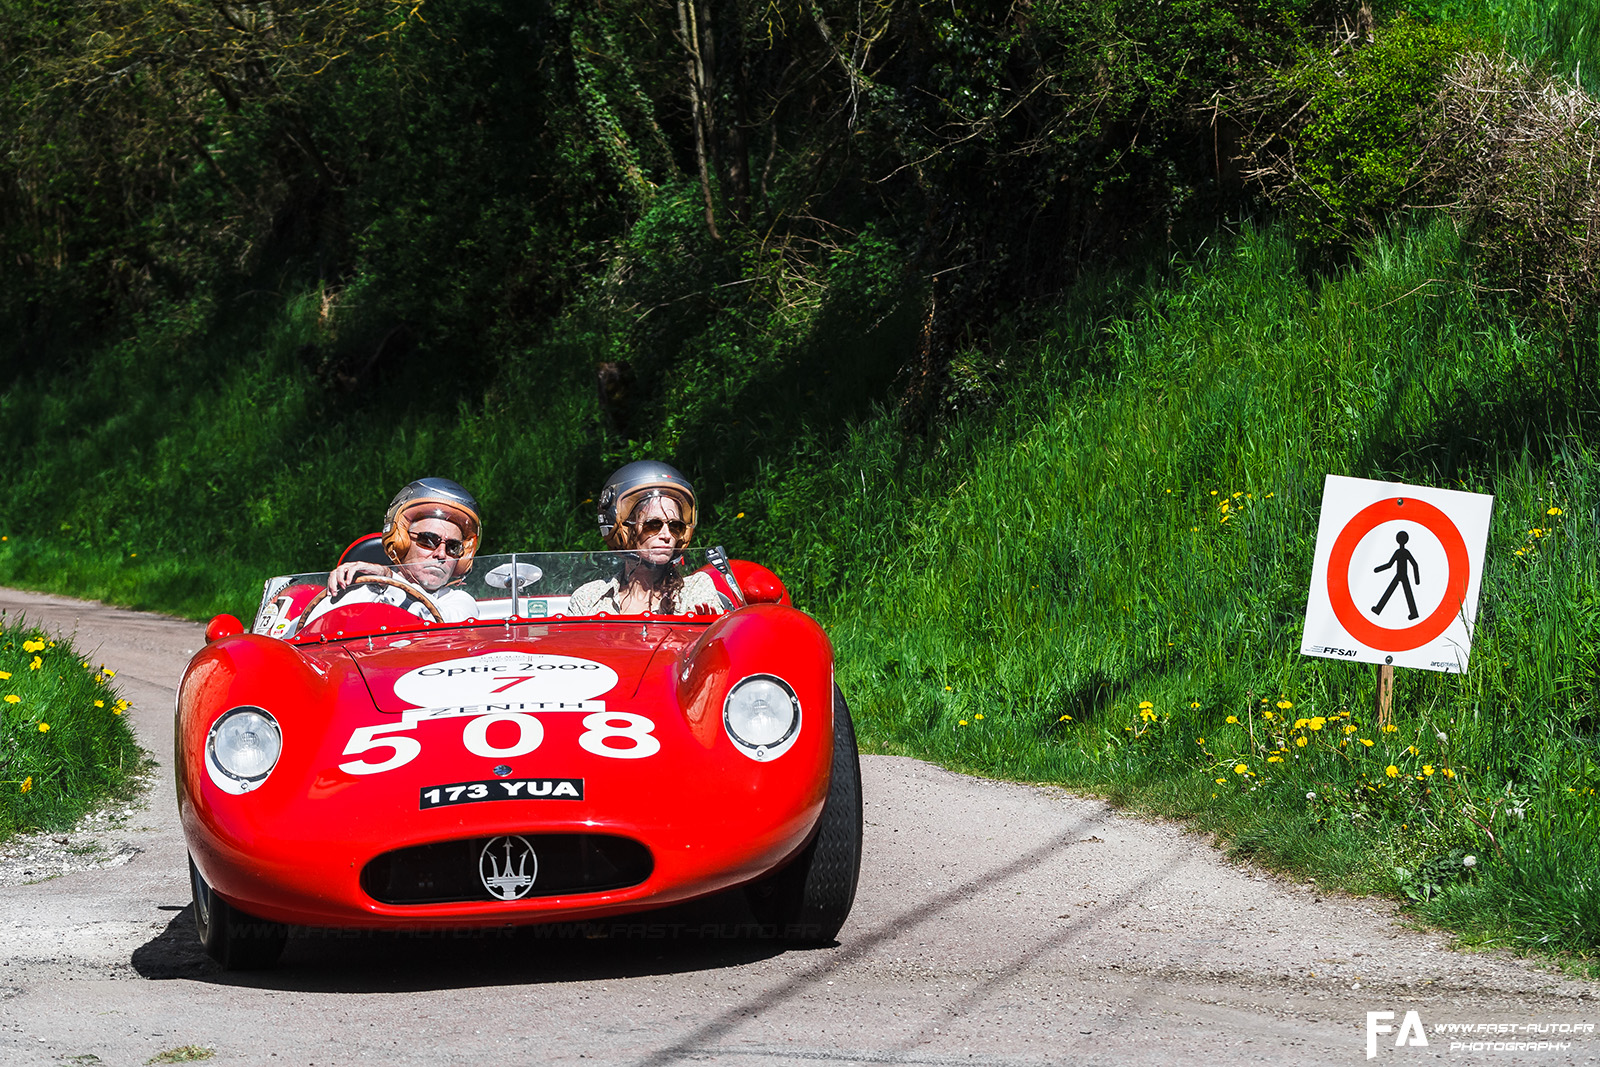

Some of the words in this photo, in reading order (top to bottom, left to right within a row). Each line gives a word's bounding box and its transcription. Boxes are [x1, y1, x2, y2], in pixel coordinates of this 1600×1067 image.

[417, 663, 507, 678] Optic
[518, 662, 601, 673] 2000
[489, 676, 536, 694] 7
[429, 702, 584, 717] ZENITH
[338, 712, 661, 775] 508
[424, 784, 489, 805] 173
[500, 782, 580, 797] YUA
